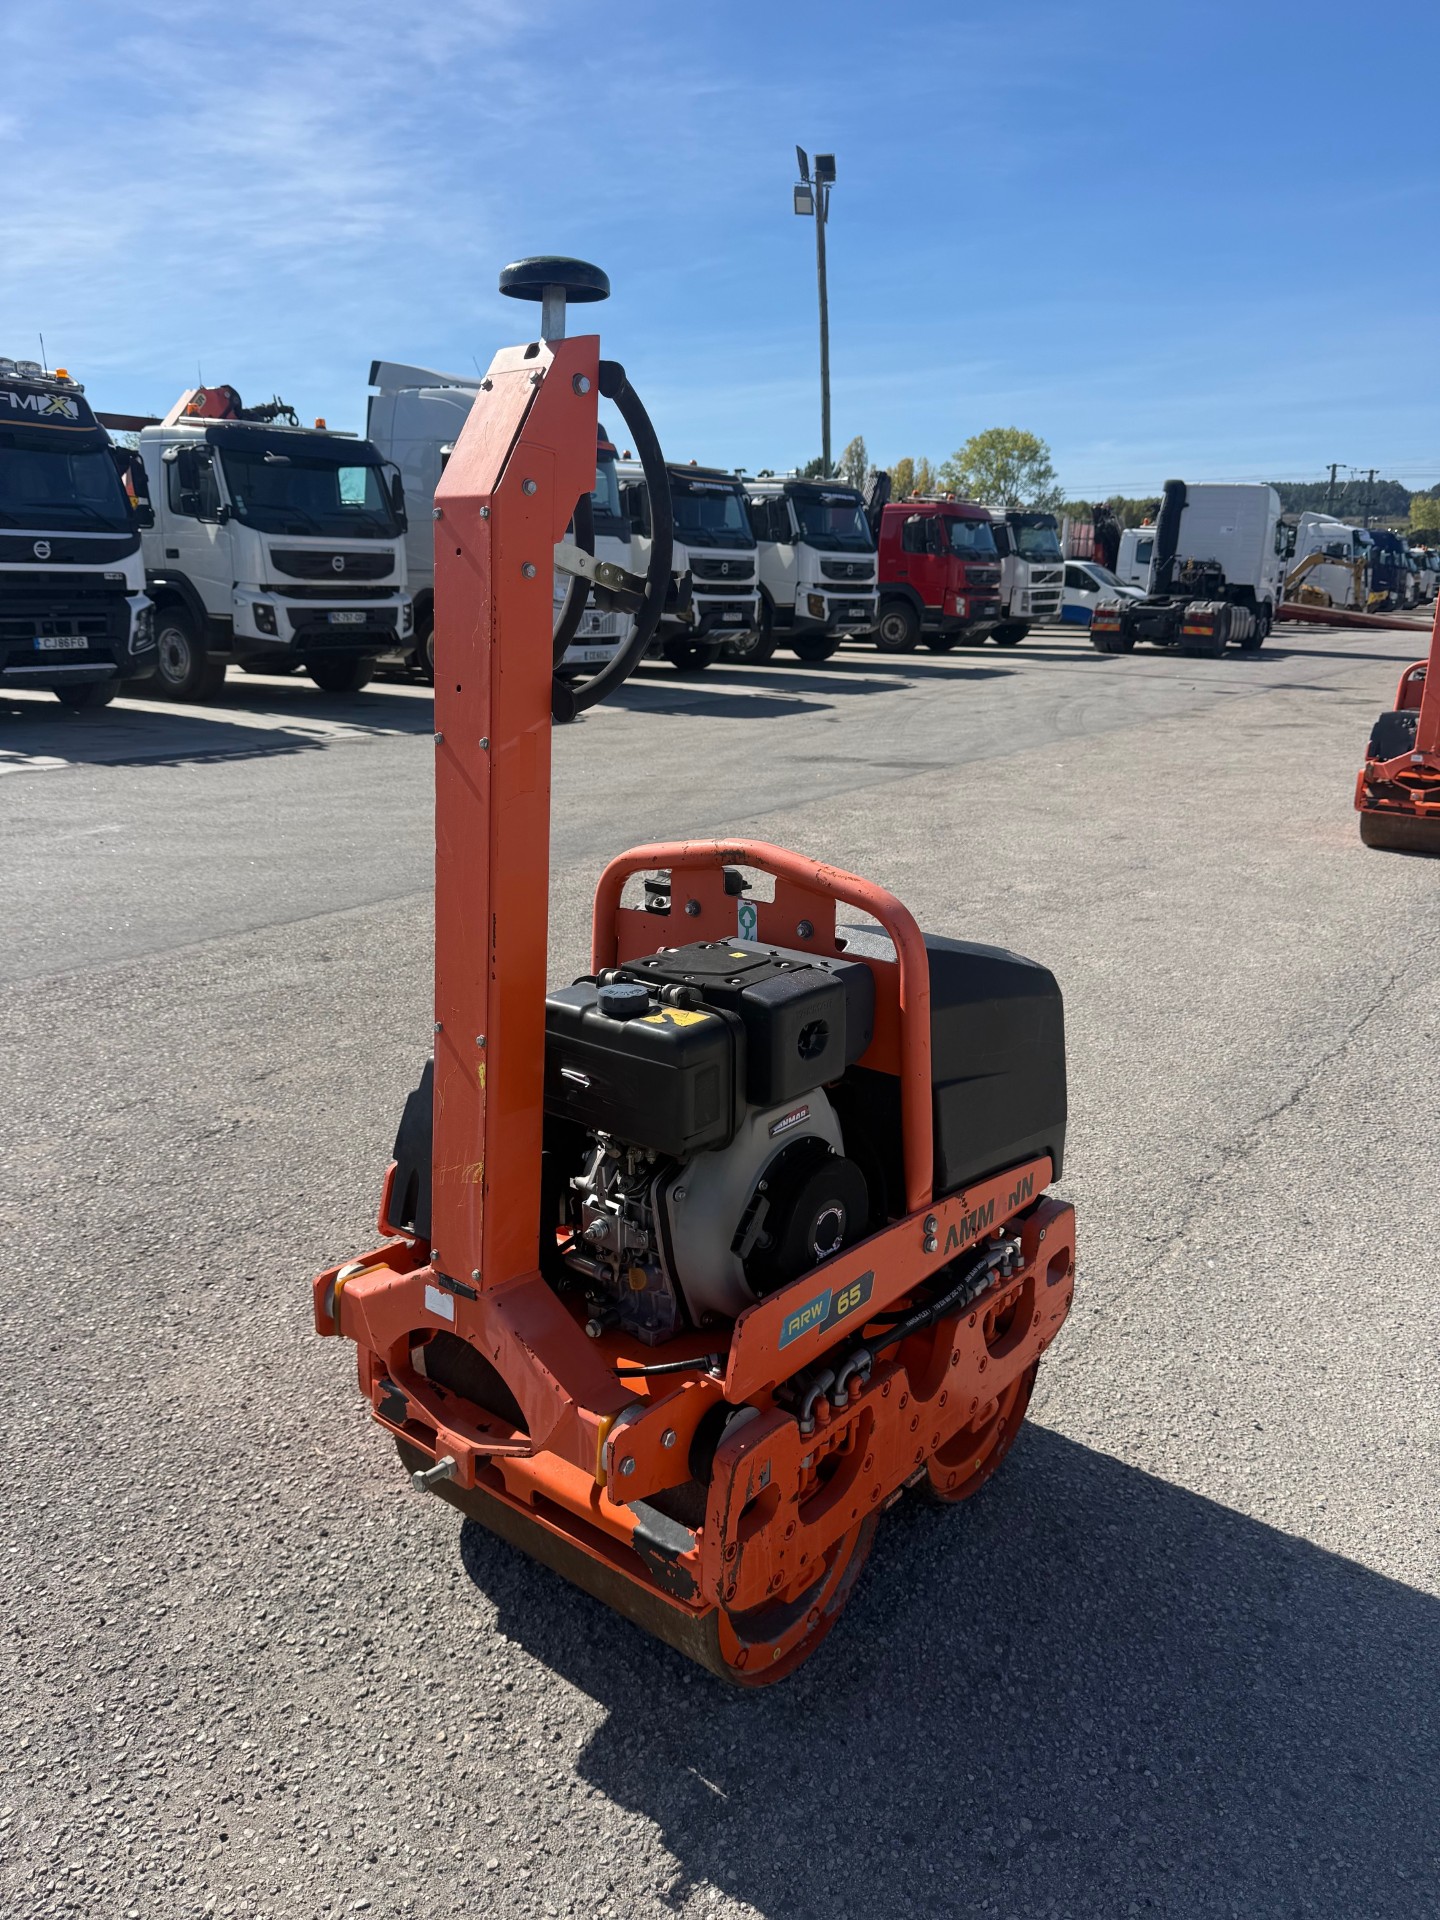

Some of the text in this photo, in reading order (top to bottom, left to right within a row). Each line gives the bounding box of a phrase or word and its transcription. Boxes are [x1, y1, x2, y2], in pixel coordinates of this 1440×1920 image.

[773, 1109, 806, 1131] NMAR
[788, 1283, 861, 1336] ARW 65
